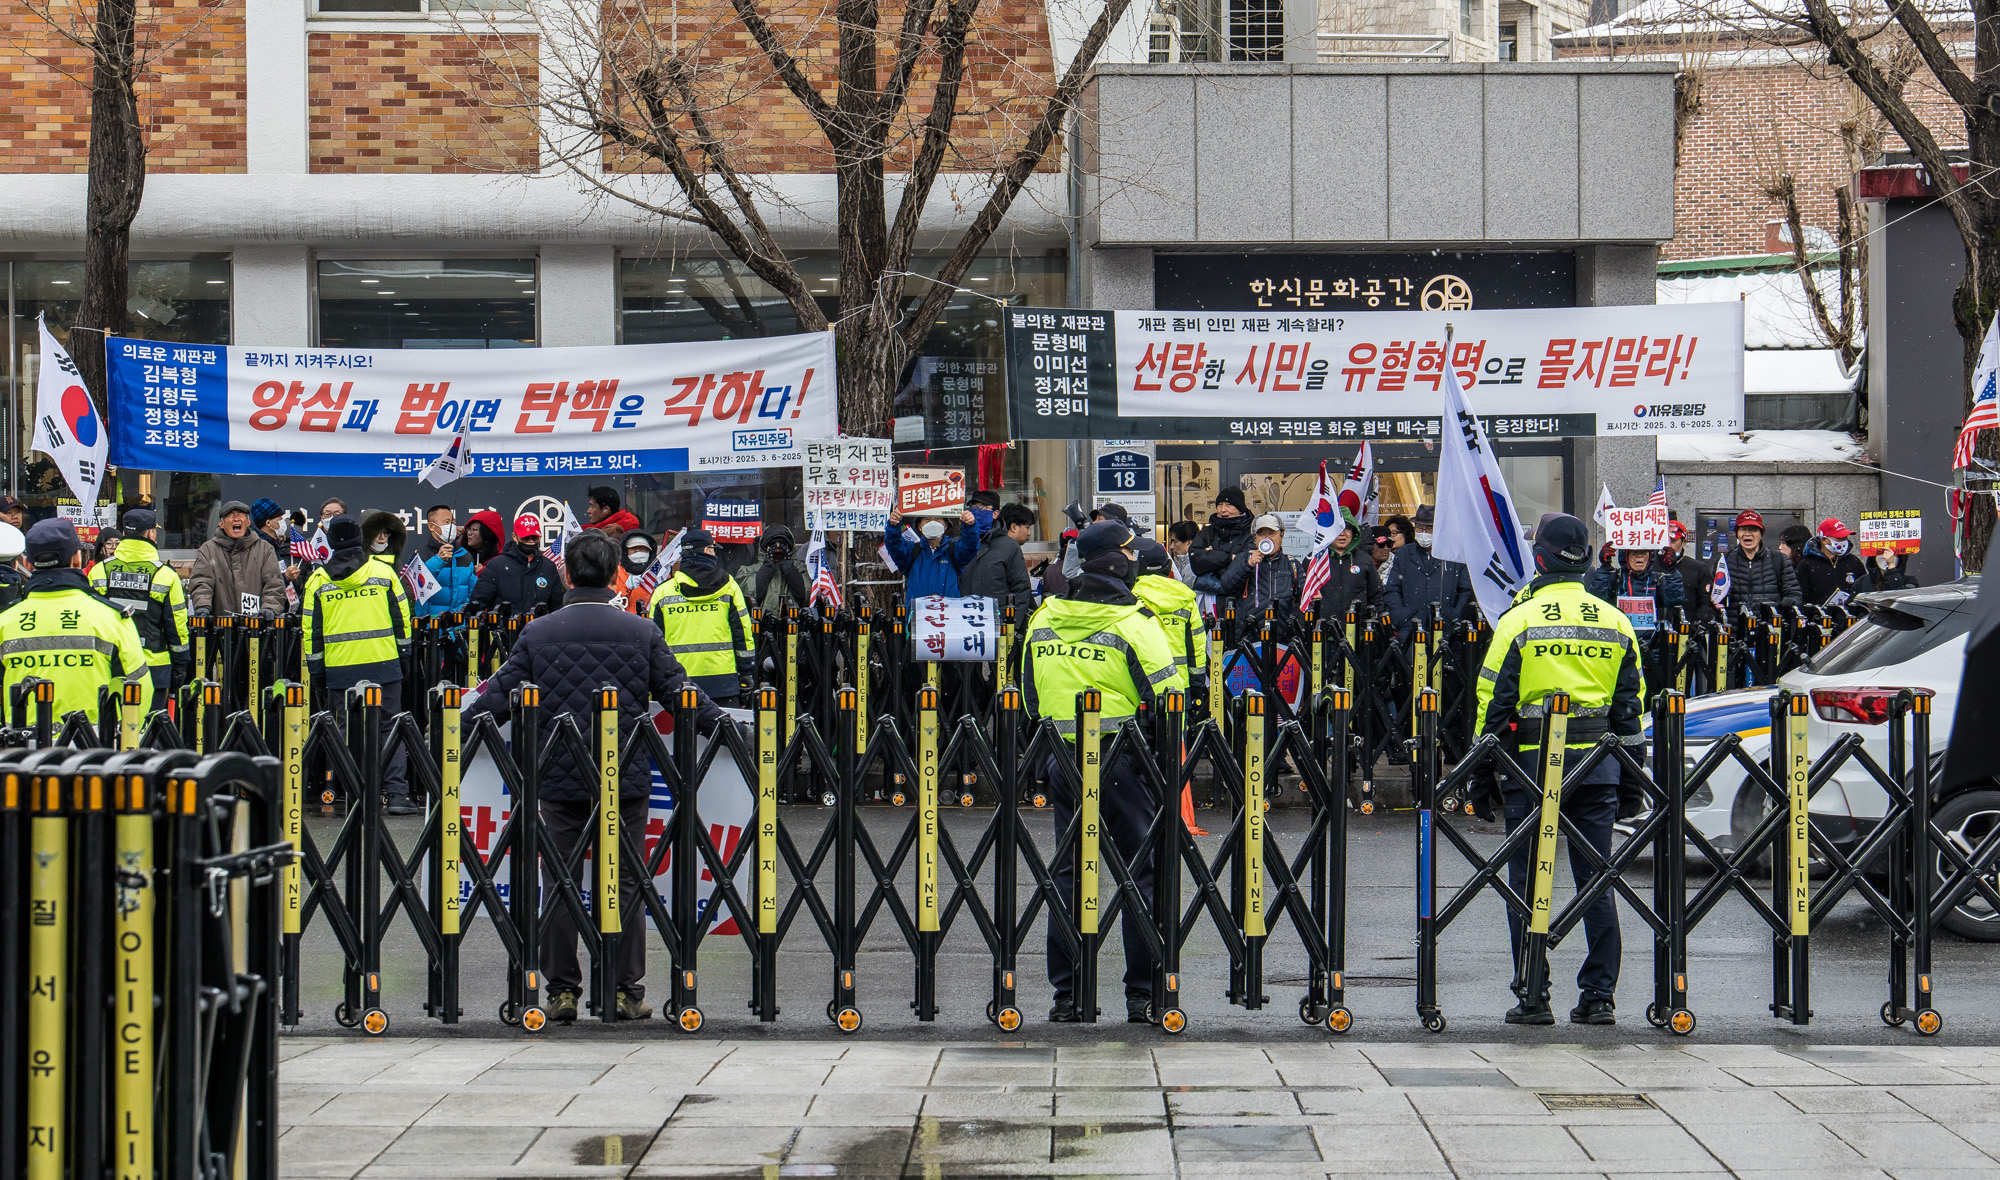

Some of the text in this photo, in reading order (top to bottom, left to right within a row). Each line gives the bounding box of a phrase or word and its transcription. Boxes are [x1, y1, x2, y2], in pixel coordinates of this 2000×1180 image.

[1249, 278, 1414, 307] 한식문화공간
[1012, 313, 1105, 331] 불의한 재판관
[1138, 318, 1344, 332] 개판 좀비 인민 재판 계속할래?
[1032, 333, 1087, 352] 문형배
[123, 344, 217, 365] 의로운 재판관
[245, 352, 373, 369] 끝까지 지켜주시오!
[1133, 334, 1698, 393] 선량한 시민을 유혈혁명으로 몰지말라!
[965, 363, 998, 374] 재판관
[1033, 354, 1088, 374] 이미선
[143, 365, 197, 386] 김복형
[942, 377, 984, 391] 문형배
[1034, 376, 1089, 396] 정계선
[143, 386, 199, 407] 김형두
[248, 368, 815, 435] 양심과 법이면 탄핵은 각하다!
[943, 394, 984, 408] 이미선
[1035, 397, 1090, 416] 정정미
[1649, 403, 1706, 417] 자유통일당
[143, 408, 199, 428] 정형식
[944, 411, 985, 425] 정계선
[1230, 421, 1273, 436] 역사와
[1279, 421, 1323, 436] 국민은
[1328, 421, 1357, 436] 회유
[1362, 420, 1391, 436] 협박
[1397, 420, 1440, 435] 매수를
[1495, 418, 1559, 434] 응징한다!
[1606, 421, 1641, 431] 표시기간:
[1644, 421, 1667, 429] 2025.
[1670, 421, 1677, 429] 3.
[1681, 420, 1713, 429] 6~2025.
[1717, 420, 1724, 428] 3.
[143, 429, 200, 449] 조한창
[737, 432, 788, 448] 자유민주당
[945, 428, 986, 441] 정정미
[383, 457, 427, 473] 국민과
[482, 455, 539, 473] 당신들을
[545, 455, 602, 472] 지켜보고
[607, 453, 642, 470] 있다.
[699, 456, 733, 465] 표시기간:
[736, 455, 758, 463] 2025.
[761, 454, 768, 462] 3.
[808, 444, 841, 464] 탄핵
[808, 467, 841, 485] 무효
[1114, 472, 1136, 488] 18
[808, 489, 847, 507] 카르텔
[902, 482, 963, 510] 탄핵각하
[706, 503, 760, 518] 헌법대로!
[705, 525, 760, 539] 탄핵무효!
[114, 581, 143, 589] POLICE
[326, 588, 378, 602] POLICE
[668, 604, 719, 615] POLICE
[1037, 645, 1106, 661] POLICE
[1534, 644, 1613, 659] POLICE
[10, 654, 94, 669] POLICE
[289, 747, 300, 909] POLICE INE
[445, 748, 460, 911] 질서유지선
[606, 750, 617, 910] POLICE LINE
[762, 750, 776, 910] 질서유지선
[924, 750, 935, 908] POLICE LINE
[1084, 751, 1099, 911] 질서유지선
[1250, 755, 1261, 913] POLICE LINE
[1535, 752, 1562, 911] 질서유지선
[1795, 755, 1806, 913] POLICE LINE
